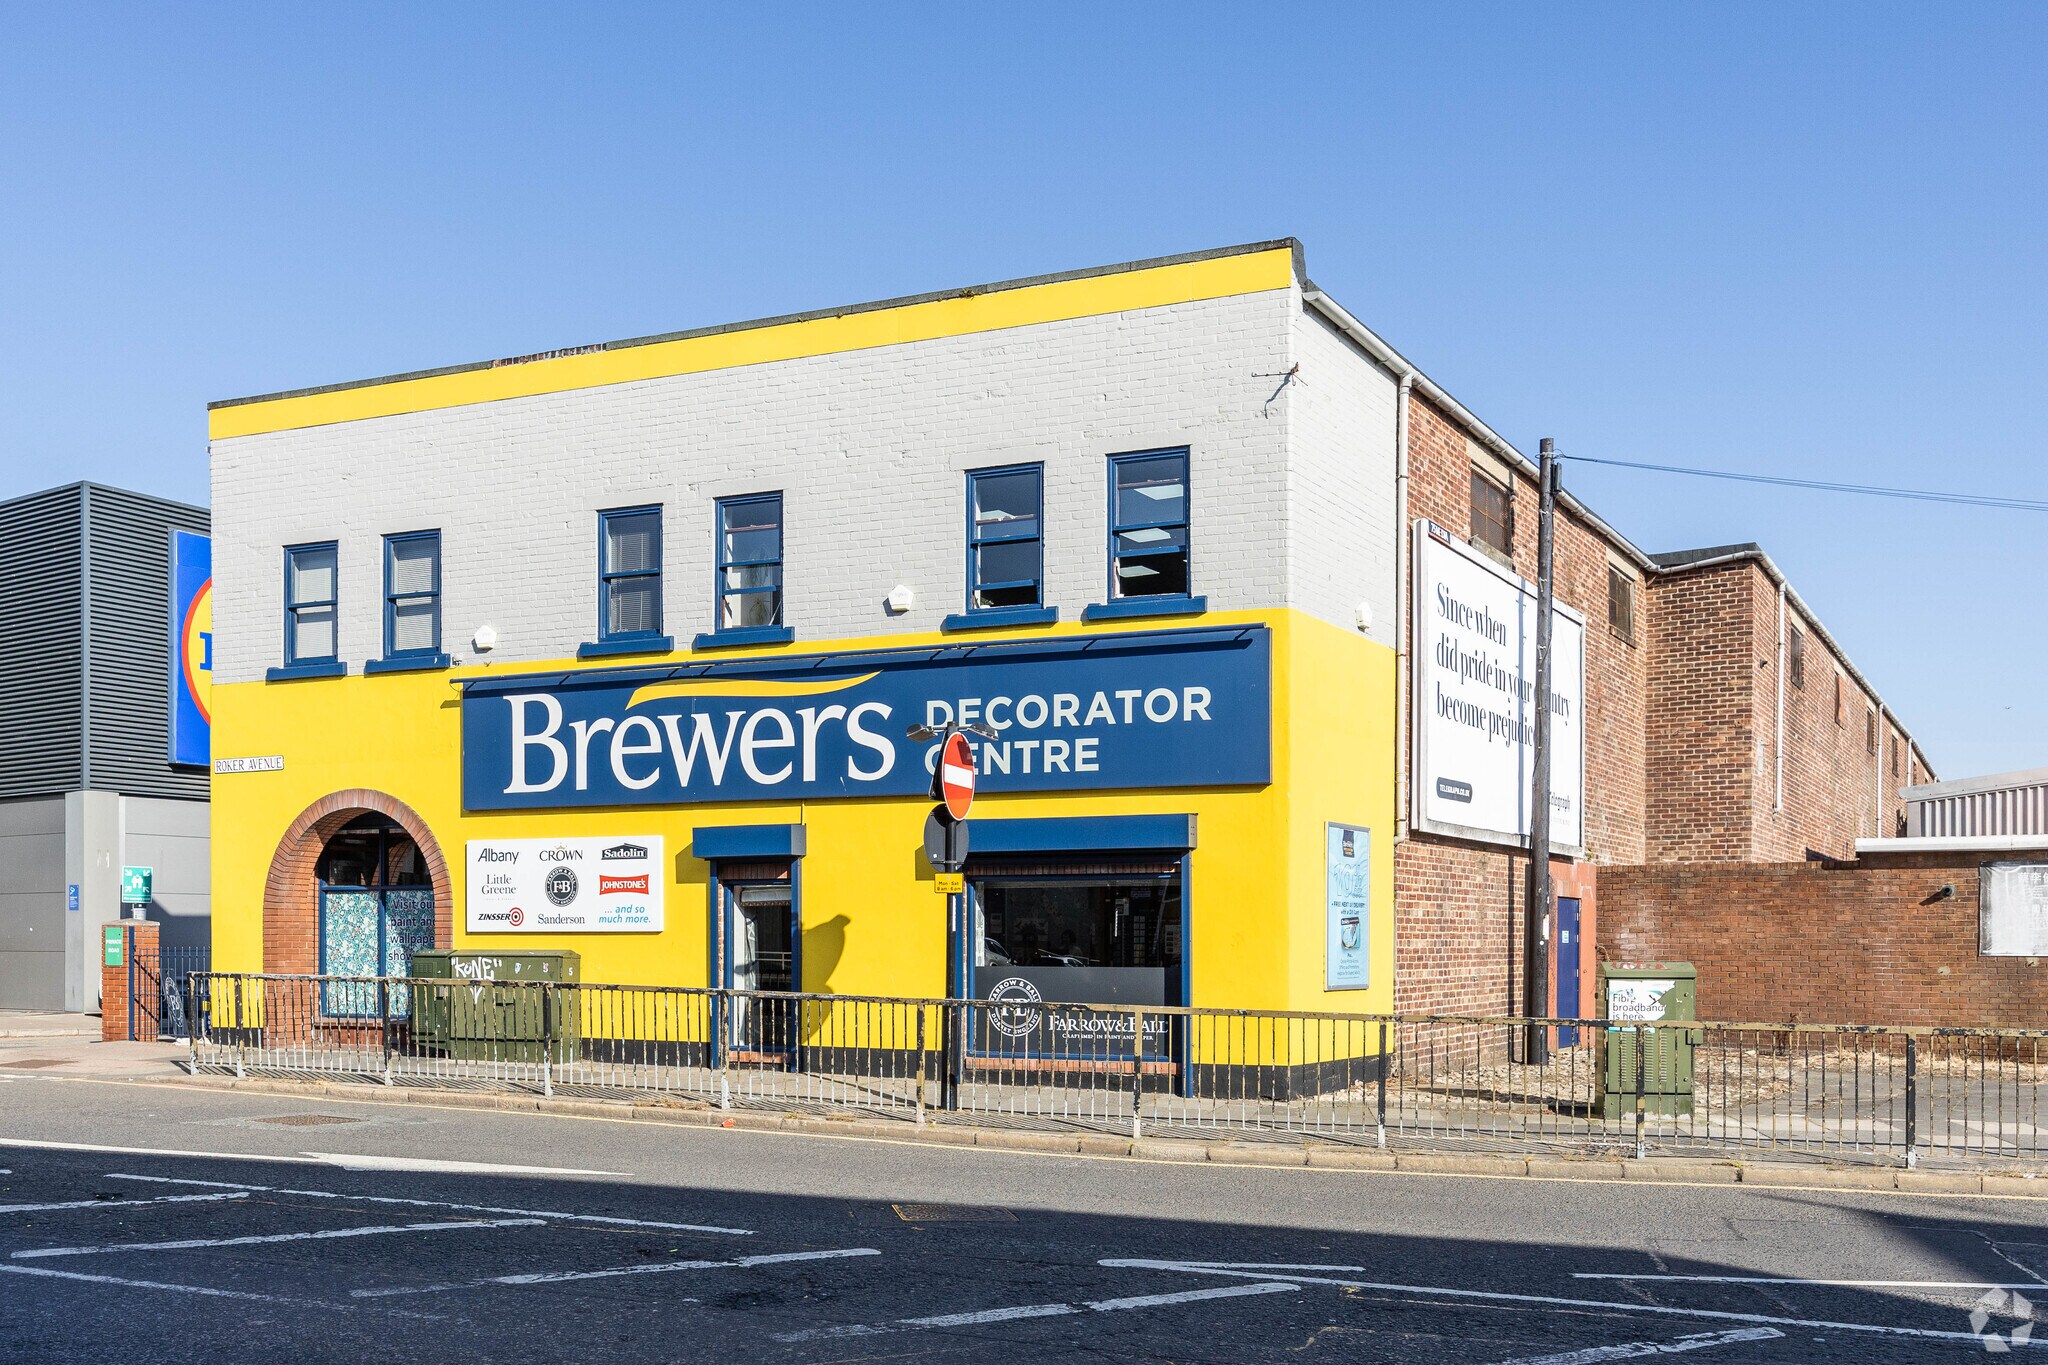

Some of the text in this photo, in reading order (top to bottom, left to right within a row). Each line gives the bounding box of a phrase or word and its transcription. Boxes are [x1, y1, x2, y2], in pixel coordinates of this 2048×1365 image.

[1437, 582, 1507, 647] Since when
[1436, 632, 1458, 673] did
[1460, 649, 1493, 687] pride
[1495, 658, 1507, 692] in
[1508, 673, 1533, 703] your
[925, 686, 1212, 731] DECORATOR
[1436, 681, 1487, 731] become
[503, 692, 896, 794] Brewers
[216, 756, 283, 772] ROKER AVENUE
[478, 847, 519, 865] Albany
[539, 849, 583, 862] CROWN
[603, 848, 645, 859] Sadolin
[486, 874, 512, 885] Little
[601, 878, 646, 891] JOHNSTONE'S
[481, 884, 517, 895] Greene
[553, 880, 571, 893] F&B
[392, 899, 417, 910] Visit
[615, 904, 631, 914] and
[634, 906, 645, 914] so
[391, 917, 417, 929] paint
[478, 913, 511, 921] ZINSSER
[537, 913, 585, 925] Sanderson
[598, 914, 651, 924] much more.
[390, 933, 435, 947] wallpape
[1612, 1012, 1620, 1020] is
